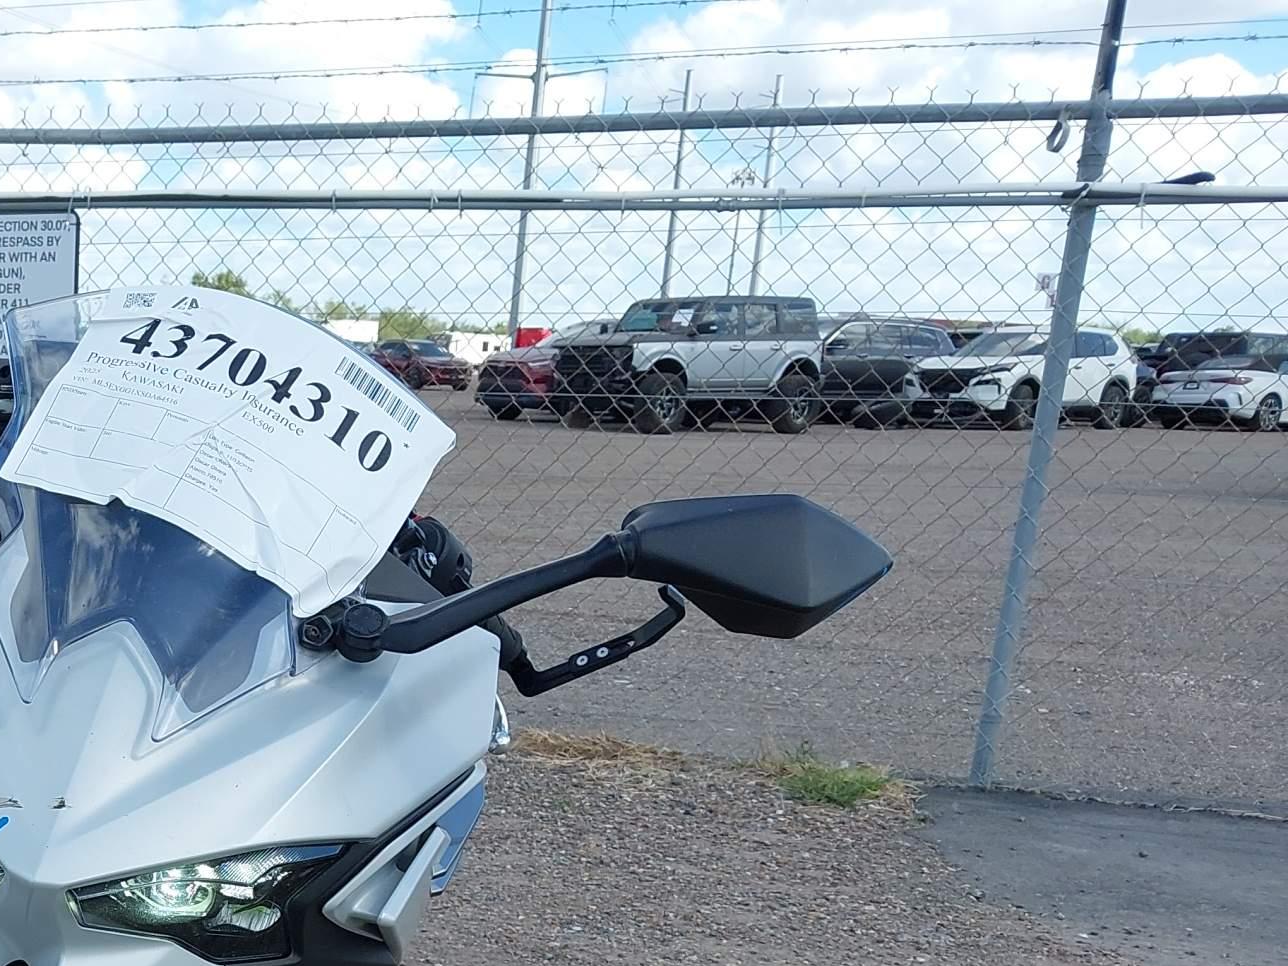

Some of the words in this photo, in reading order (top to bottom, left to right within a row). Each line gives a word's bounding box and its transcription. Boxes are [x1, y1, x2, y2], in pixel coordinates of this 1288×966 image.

[8, 252, 37, 262] WITH
[40, 251, 56, 262] AN
[47, 236, 61, 246] BY
[87, 352, 169, 375] Progressive
[173, 368, 238, 398] Casualty
[241, 390, 304, 437] Insurance
[119, 318, 393, 472] 43704310
[122, 370, 184, 394] KAWASAKI
[241, 411, 275, 434] EX500
